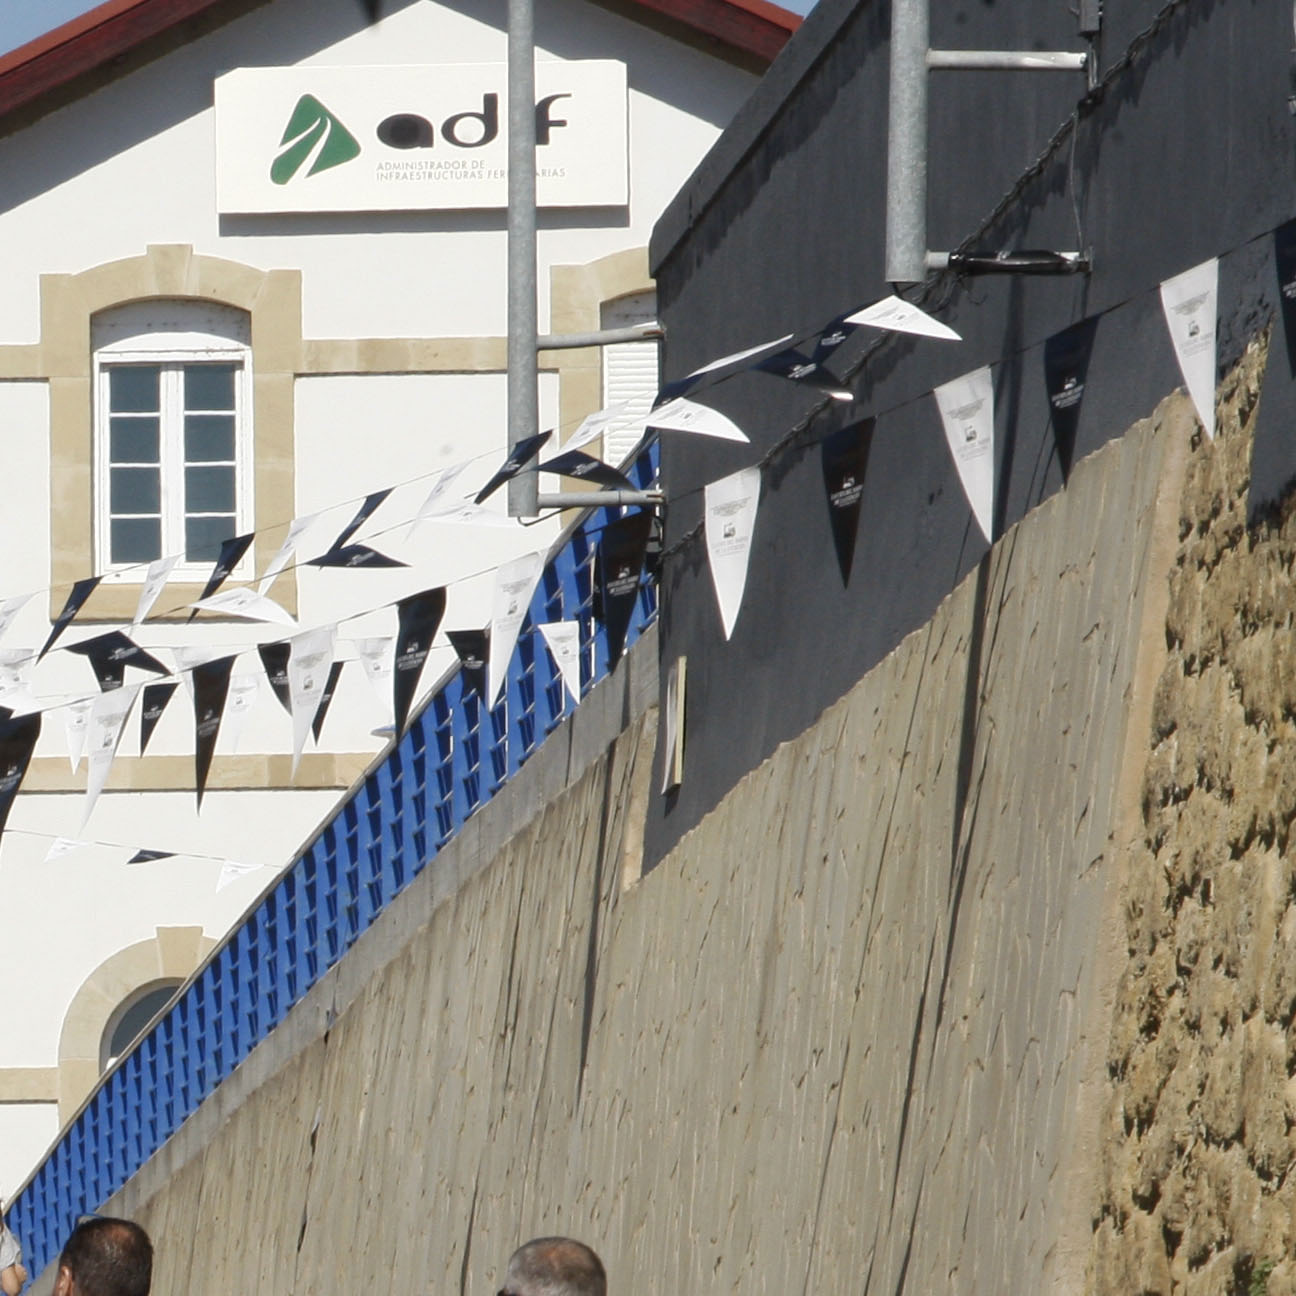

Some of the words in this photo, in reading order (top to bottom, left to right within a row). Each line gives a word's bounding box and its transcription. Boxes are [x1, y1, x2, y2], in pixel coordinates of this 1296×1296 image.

[377, 93, 571, 150] adf
[376, 160, 468, 171] ADMINISTRADOR
[471, 160, 486, 170] DE
[376, 170, 483, 181] INFRAESTRUCTURAS
[487, 168, 566, 179] FERRIAS
